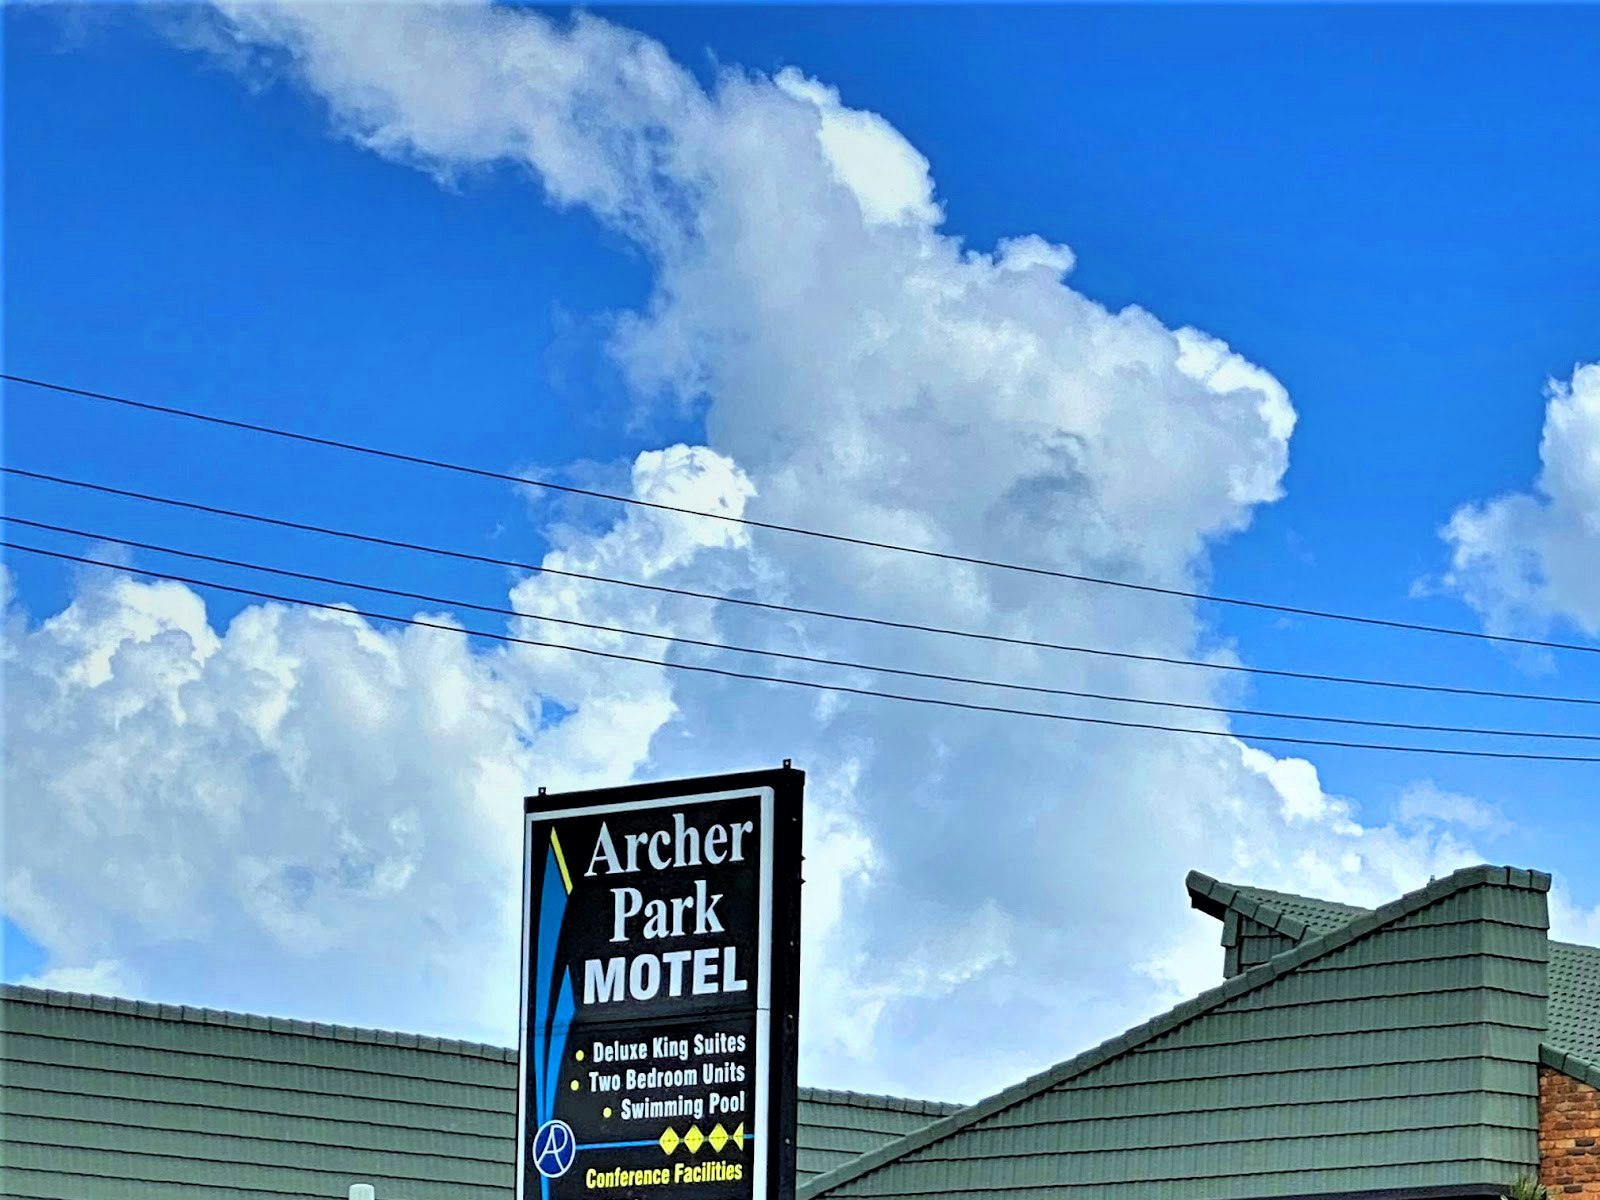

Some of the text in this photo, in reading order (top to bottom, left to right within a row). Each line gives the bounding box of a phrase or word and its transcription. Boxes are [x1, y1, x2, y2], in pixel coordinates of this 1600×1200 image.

[584, 813, 754, 877] Archer
[609, 880, 725, 942] Park
[583, 946, 748, 1005] MOTEL
[593, 1033, 746, 1062] Deluxe King Suites
[589, 1062, 745, 1092] Two Bedroom Units
[621, 1091, 745, 1119] Swimming Pool
[586, 1161, 743, 1189] Conference Facilities
